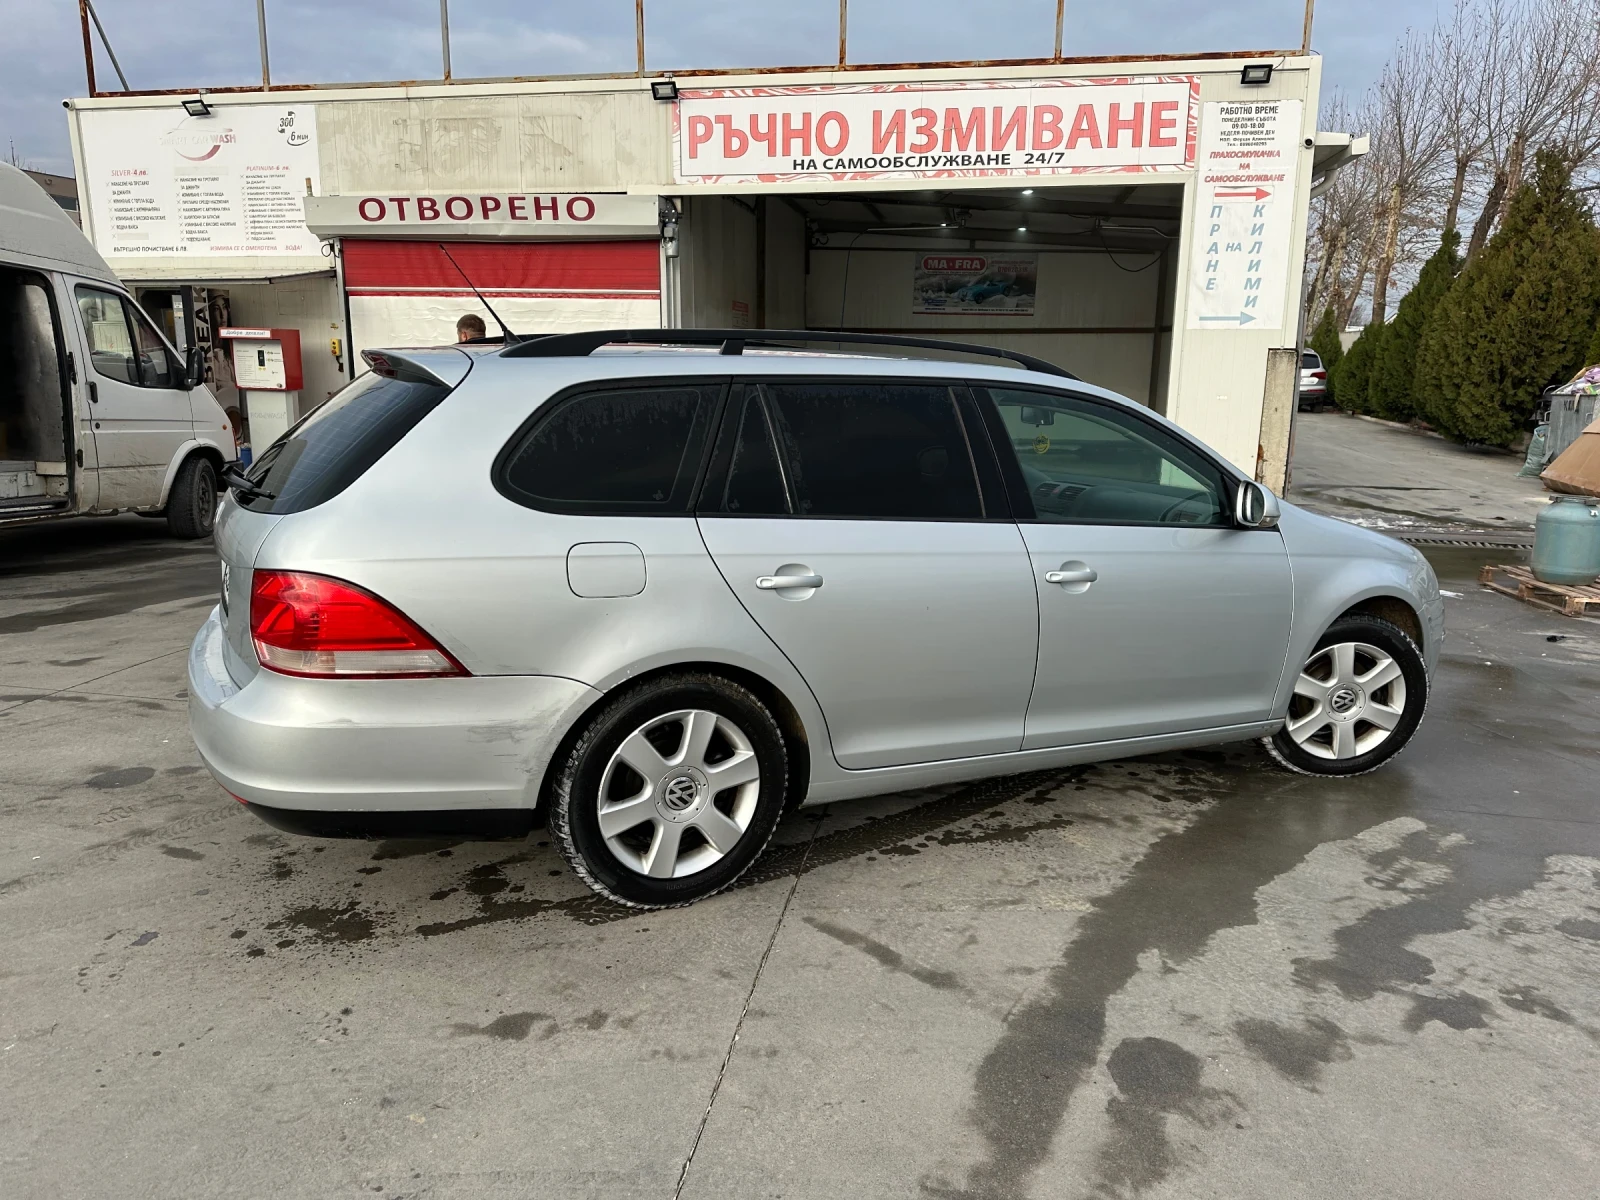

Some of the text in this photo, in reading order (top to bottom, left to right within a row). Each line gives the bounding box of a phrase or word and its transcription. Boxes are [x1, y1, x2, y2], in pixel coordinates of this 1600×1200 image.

[1220, 106, 1279, 115] РАБОТНО ВРЕМЕ
[279, 117, 294, 127] 300
[688, 100, 1179, 159] РЪЧНО ИЗМИВАНЕ
[210, 134, 237, 144] WASH
[291, 131, 296, 141] 6
[1209, 150, 1281, 159] ПРАХОСМУКАЧКА
[792, 152, 1065, 171] НА САМООБСЛУЖВАНЕ 24/7
[1204, 174, 1285, 183] САМООБСЛУЖВАНЕ
[358, 196, 596, 222] ОТВОРЕНО
[1205, 205, 1223, 290] ПРАНЕ
[1225, 242, 1242, 252] НА
[1243, 205, 1266, 308] КИЛИМИ
